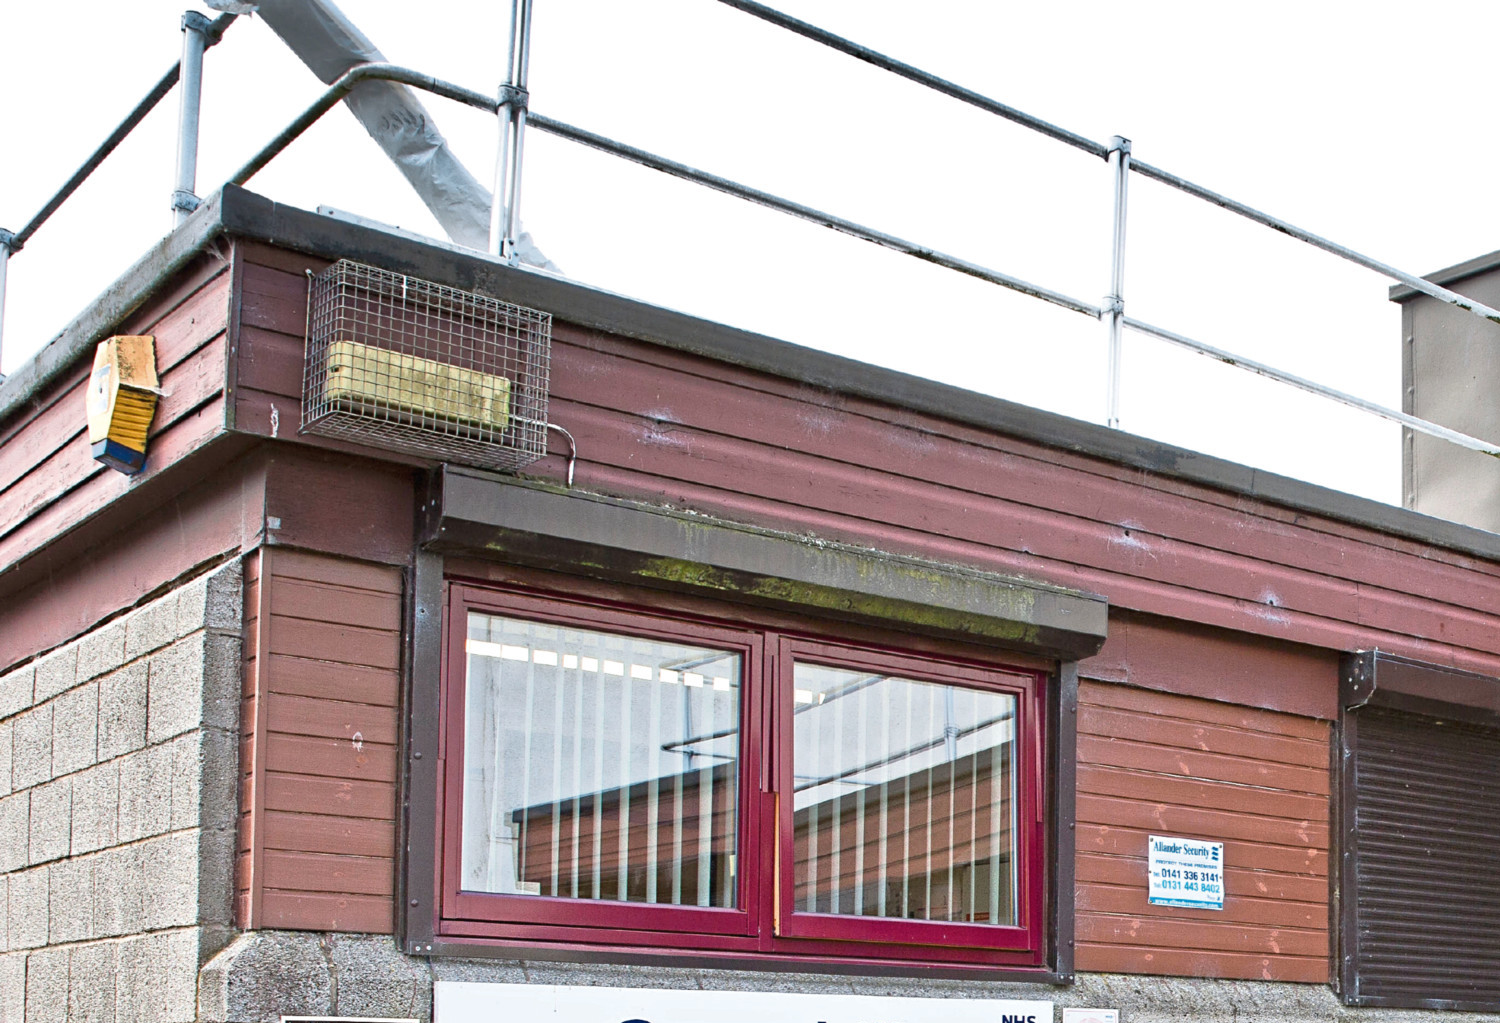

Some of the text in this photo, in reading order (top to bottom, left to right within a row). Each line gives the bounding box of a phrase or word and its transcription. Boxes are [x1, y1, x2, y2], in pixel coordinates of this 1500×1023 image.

[1154, 841, 1209, 859] Allander Security
[1162, 869, 1180, 878] 0141
[1184, 871, 1198, 880] 336
[1201, 873, 1218, 882] 3141
[1162, 880, 1181, 890] 0131
[1184, 882, 1198, 891] 443
[1201, 884, 1220, 893] 8402
